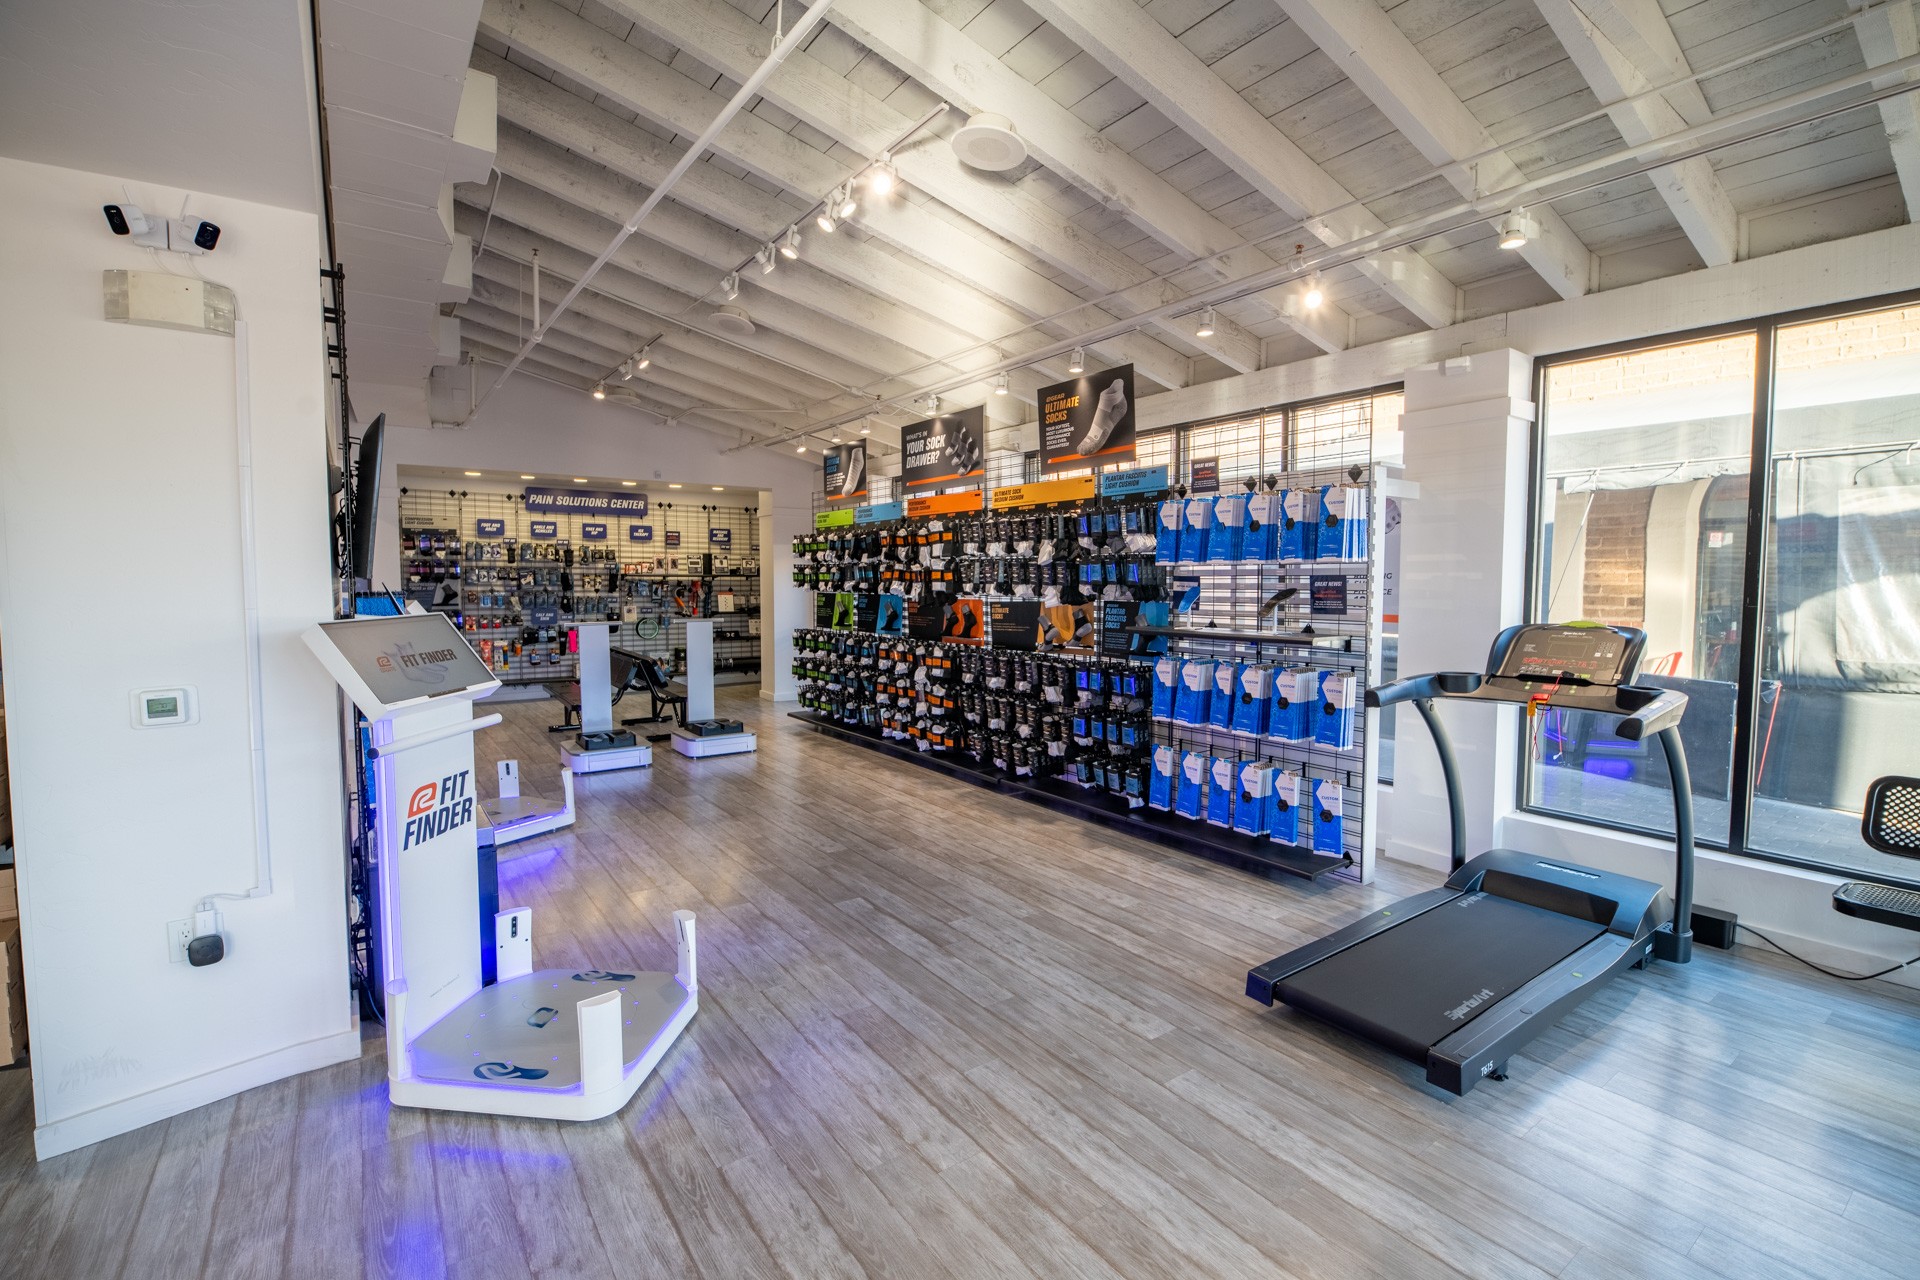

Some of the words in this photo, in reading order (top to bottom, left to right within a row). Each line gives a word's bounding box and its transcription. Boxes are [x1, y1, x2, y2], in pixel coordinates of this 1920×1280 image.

[1045, 396, 1080, 413] ULTIMATE
[1045, 410, 1067, 424] SOCKS
[906, 431, 922, 440] WHAT'S
[906, 439, 925, 455] YOUR
[926, 434, 946, 450] SOCK
[906, 450, 940, 469] DRAWER?
[1105, 473, 1125, 483] PLANTAR
[1105, 482, 1118, 490] LIGHT
[1118, 480, 1140, 488] CUSHION
[994, 489, 1012, 497] ULTIMATE
[1009, 494, 1024, 502] CUSHION
[529, 494, 554, 505] PAIN
[556, 496, 608, 508] SOLUTIONS
[610, 498, 645, 510] CENTER
[400, 654, 420, 668] FIT
[418, 648, 458, 665] FINDER
[440, 770, 469, 806] FIT
[403, 796, 473, 852] FINDER
[1481, 1060, 1494, 1077] T615
